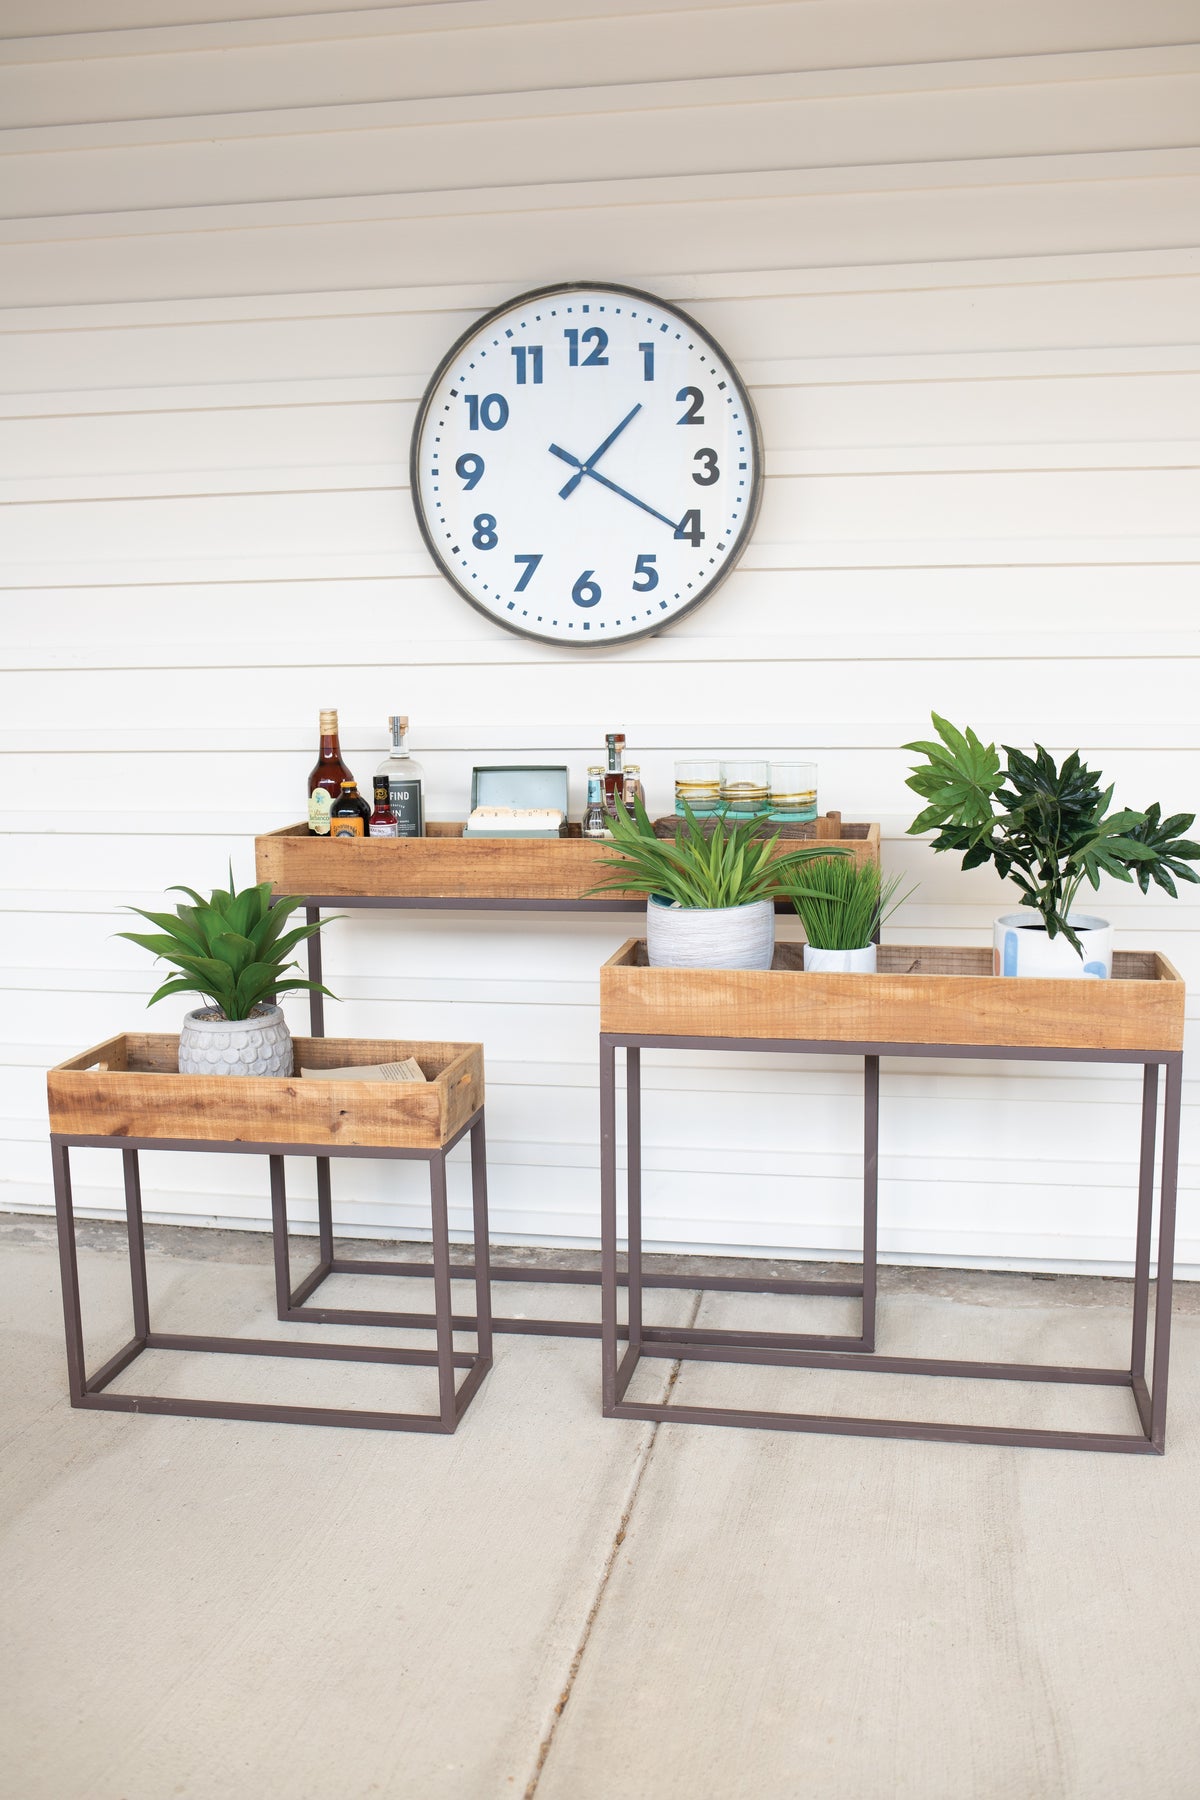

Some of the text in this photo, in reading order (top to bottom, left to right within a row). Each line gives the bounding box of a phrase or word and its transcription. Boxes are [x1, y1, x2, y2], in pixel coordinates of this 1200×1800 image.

[511, 345, 543, 385] 11
[564, 326, 609, 367] 12
[638, 342, 655, 382] 1
[464, 392, 509, 431] 10
[675, 385, 705, 425] 2
[455, 452, 485, 491] 9
[691, 447, 720, 486] 3
[471, 512, 499, 551] 8
[673, 508, 705, 548] 4
[513, 554, 543, 592] 7
[571, 569, 602, 608] 6
[632, 554, 659, 592] 5
[389, 791, 410, 801] FIND
